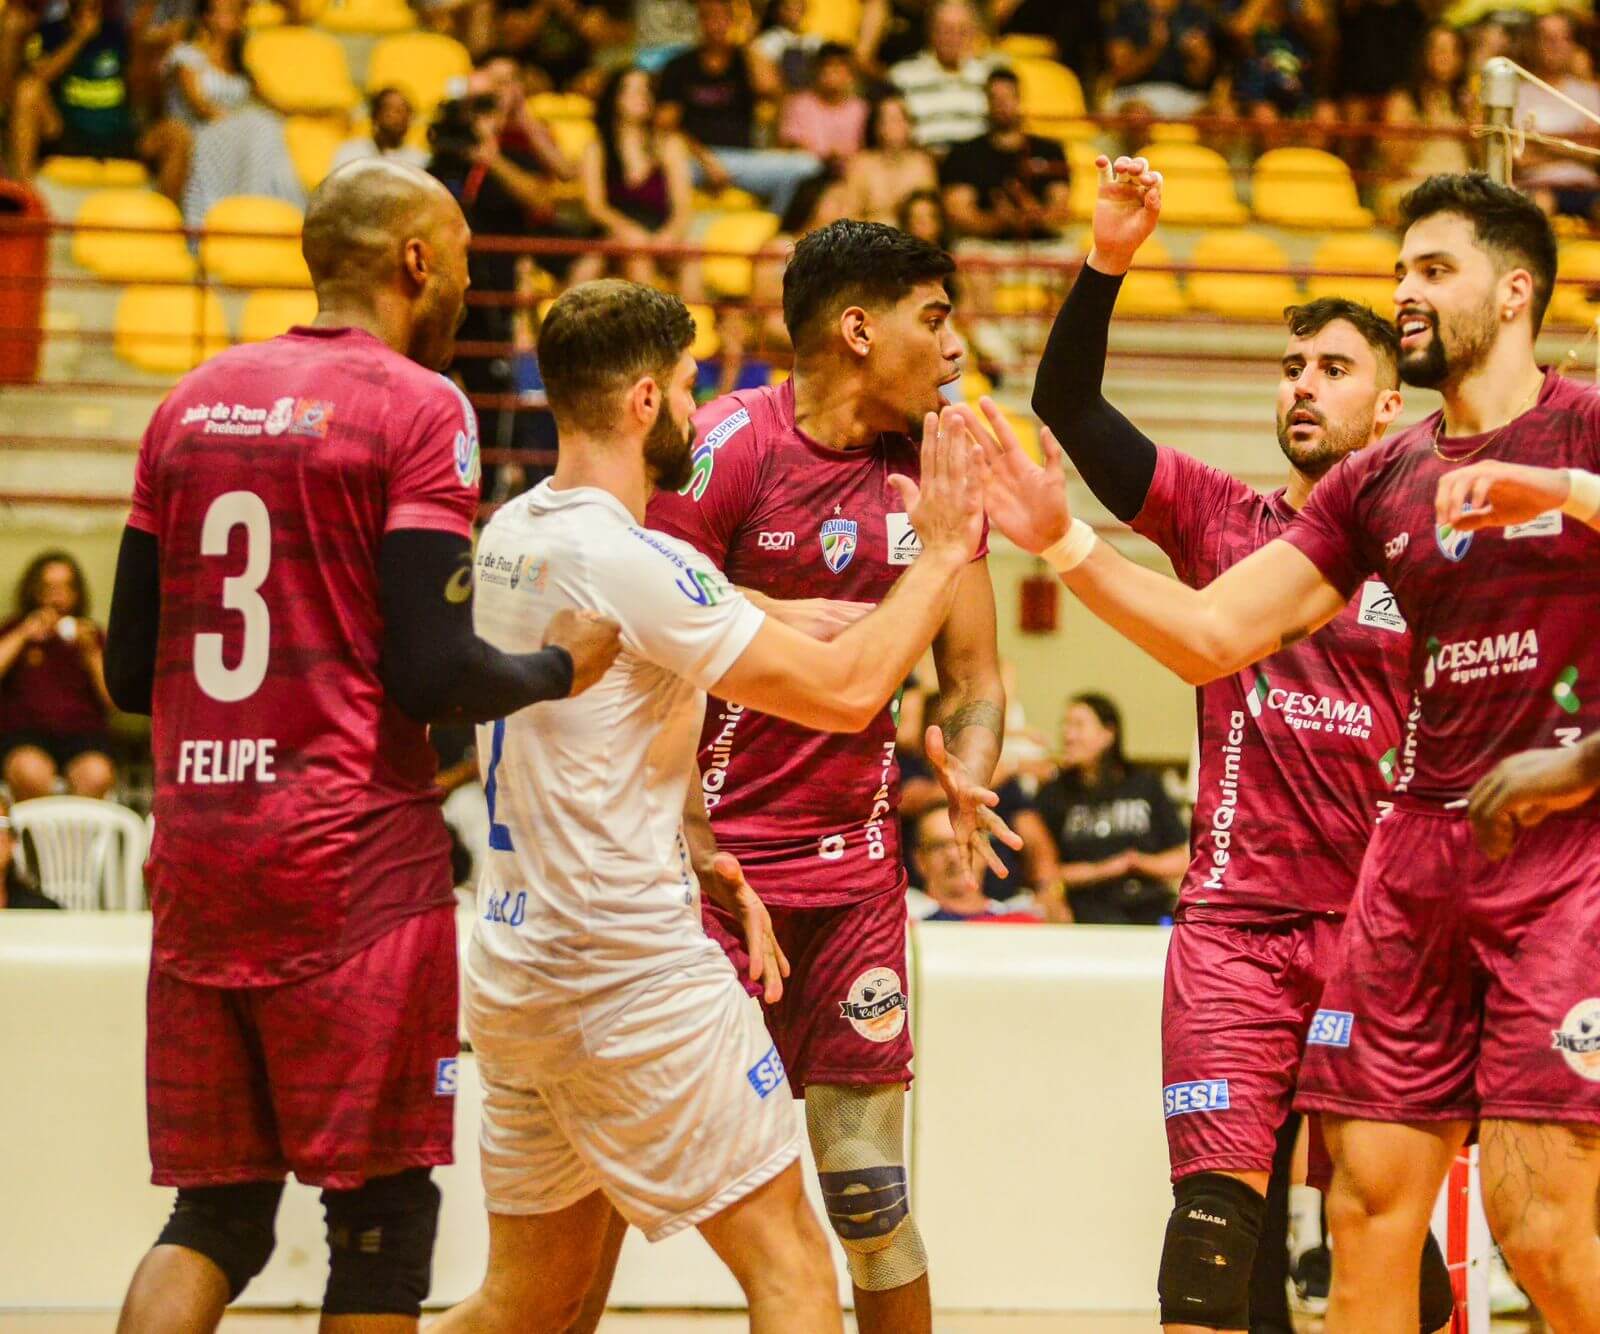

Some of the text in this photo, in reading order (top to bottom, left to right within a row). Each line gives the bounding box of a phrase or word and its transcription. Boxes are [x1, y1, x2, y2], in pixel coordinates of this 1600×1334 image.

[211, 402, 231, 420] de
[707, 410, 748, 446] SUPREM
[194, 491, 271, 702] 3
[1437, 629, 1538, 671] CESAMA
[1503, 656, 1538, 673] vida
[1267, 688, 1373, 727] CESAMA
[1285, 713, 1371, 740] água é vida
[177, 738, 277, 784] FELIPE
[702, 700, 745, 817] dQuimic
[1203, 710, 1245, 889] MedQuimica
[1310, 1015, 1345, 1042] ESI
[1165, 1084, 1219, 1113] SESI
